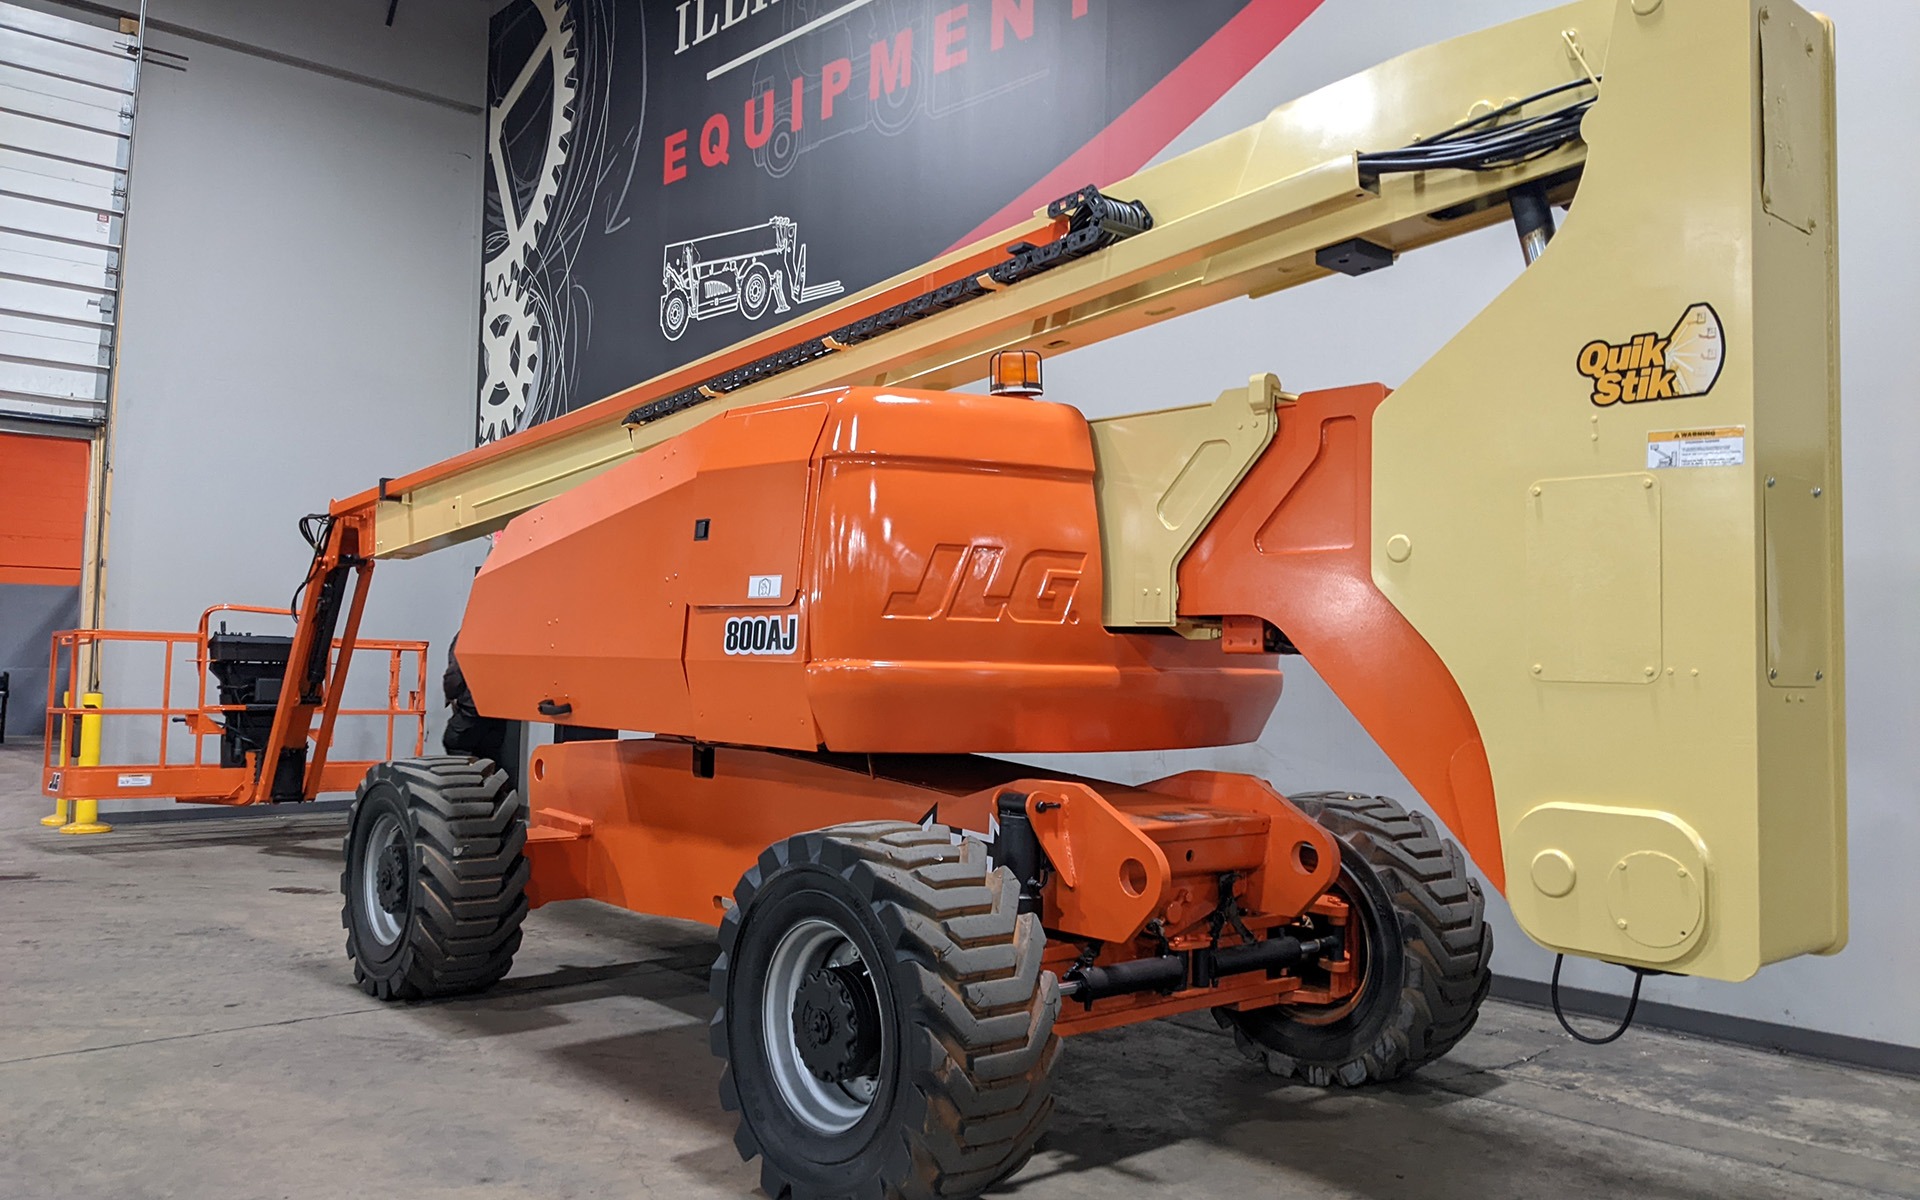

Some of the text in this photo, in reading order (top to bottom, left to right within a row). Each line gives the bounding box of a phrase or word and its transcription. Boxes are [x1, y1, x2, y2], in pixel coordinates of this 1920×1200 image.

[674, 0, 779, 55] ILL
[1579, 334, 1668, 379] Quik
[1593, 366, 1676, 405] Stik
[1681, 430, 1716, 438] WARNING
[725, 618, 796, 651] 800AJ
